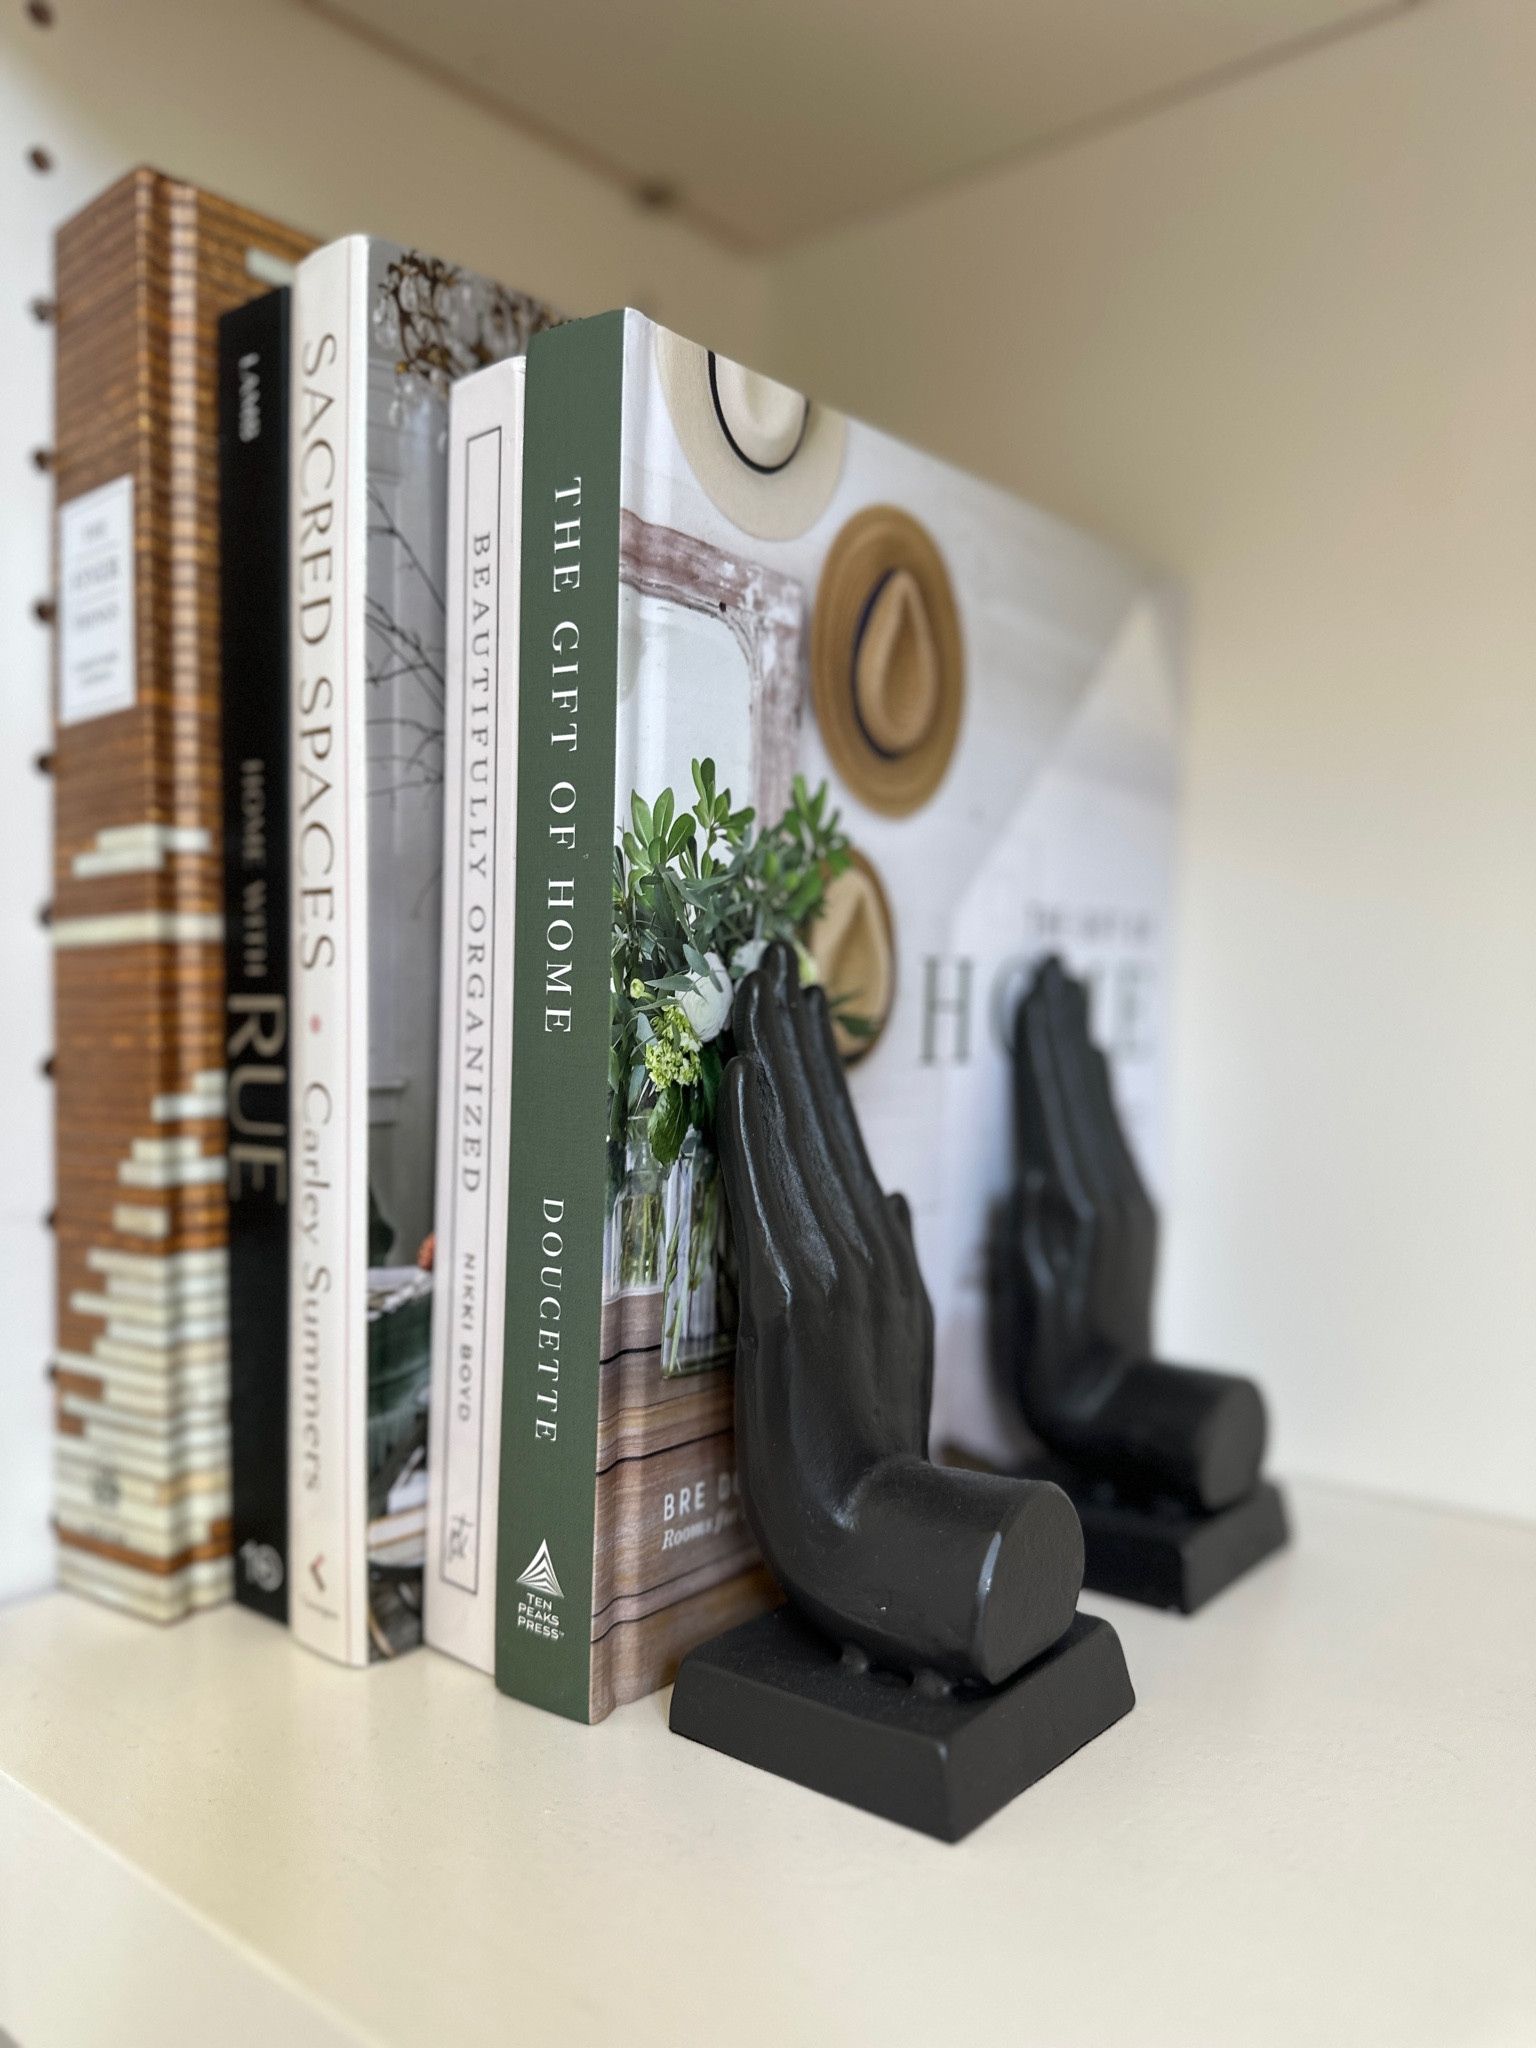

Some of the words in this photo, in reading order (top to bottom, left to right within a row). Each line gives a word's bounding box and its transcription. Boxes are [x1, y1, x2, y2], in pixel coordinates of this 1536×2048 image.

[300, 333, 337, 647] SACRED
[553, 476, 582, 593] THE
[468, 531, 492, 879] BEAUTIFULLY
[551, 621, 580, 752] GIFT
[299, 676, 335, 971] SPACES
[549, 781, 577, 850] OF
[545, 877, 575, 1034] HOME
[227, 993, 287, 1204] RUE
[461, 905, 487, 1193] ORGANIZED
[300, 1081, 333, 1245] Carley
[462, 1252, 476, 1331] NIKKI
[535, 1198, 565, 1443] DOUCETTE
[302, 1261, 332, 1492] Summers
[457, 1343, 473, 1423] BOYD
[663, 1480, 706, 1522] BRE
[517, 1602, 560, 1628] PEAKS
[526, 1592, 552, 1612] TEN
